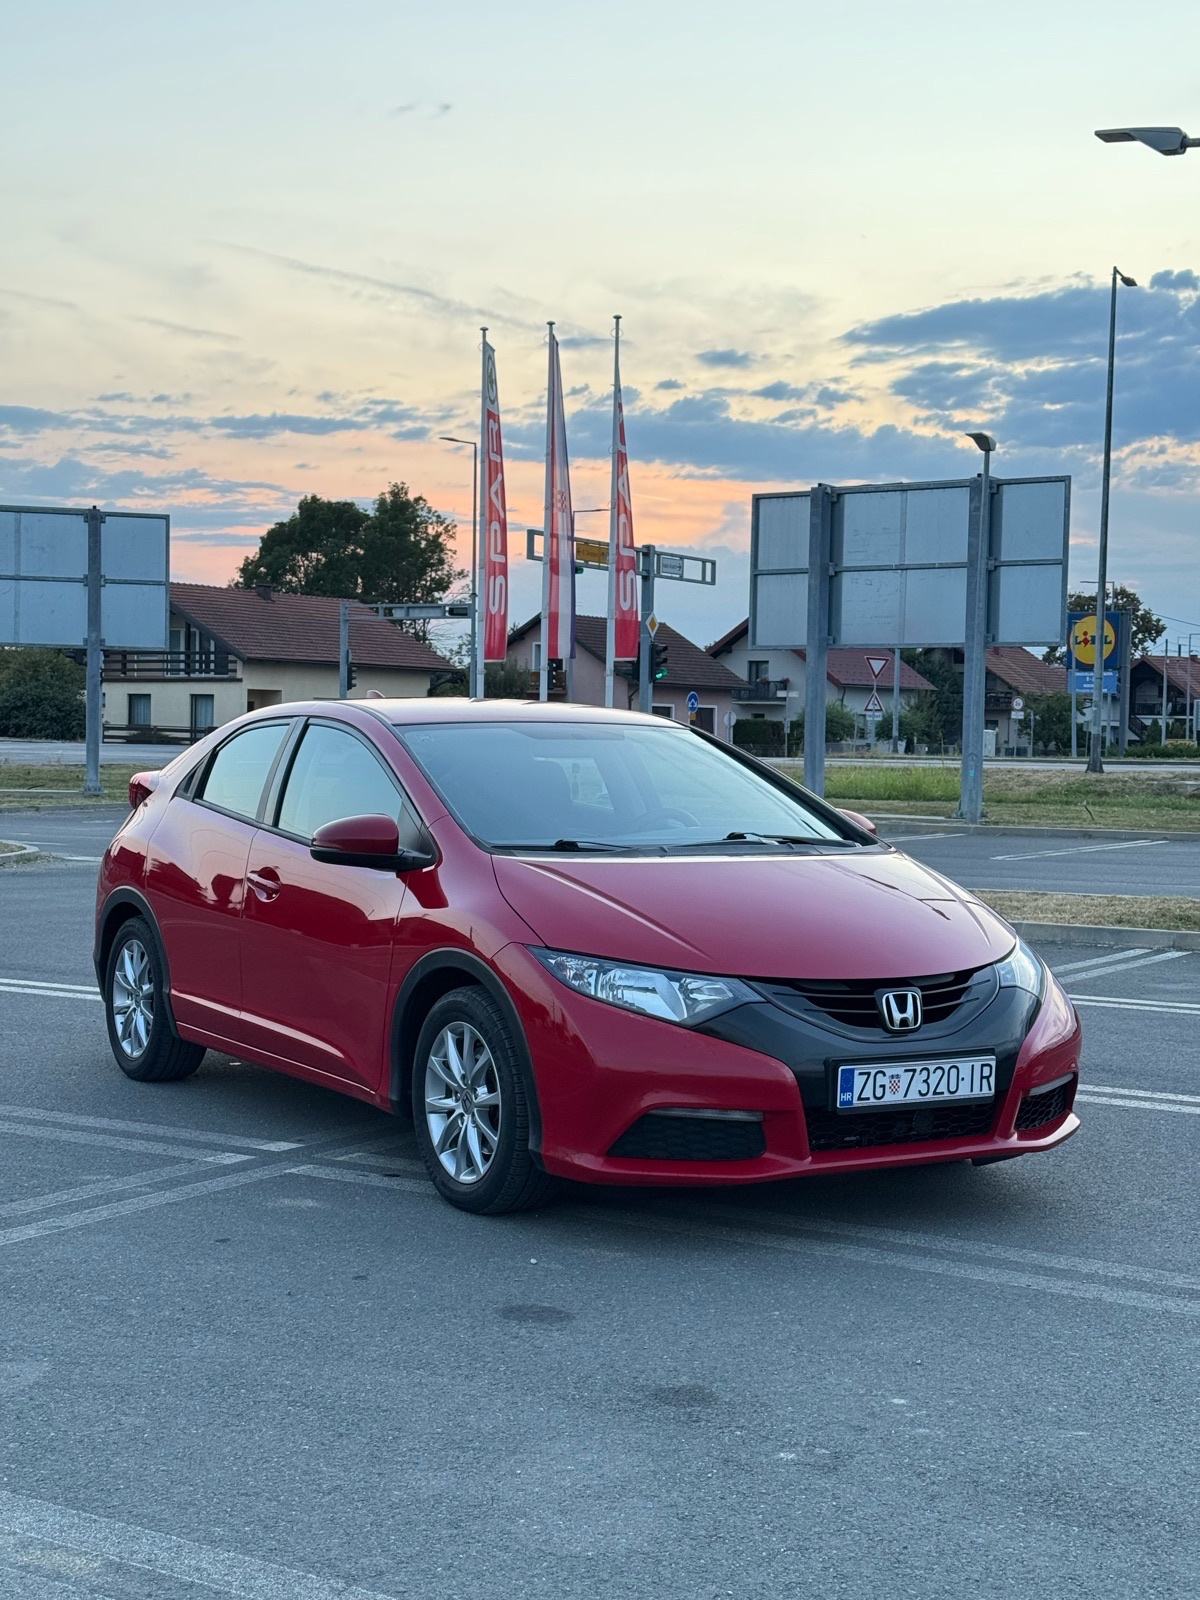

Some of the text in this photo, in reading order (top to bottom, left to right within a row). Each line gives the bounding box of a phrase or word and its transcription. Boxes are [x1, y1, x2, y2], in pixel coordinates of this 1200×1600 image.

[488, 418, 506, 616] SPAR
[840, 1092, 853, 1102] HR
[856, 1069, 887, 1102] ZG
